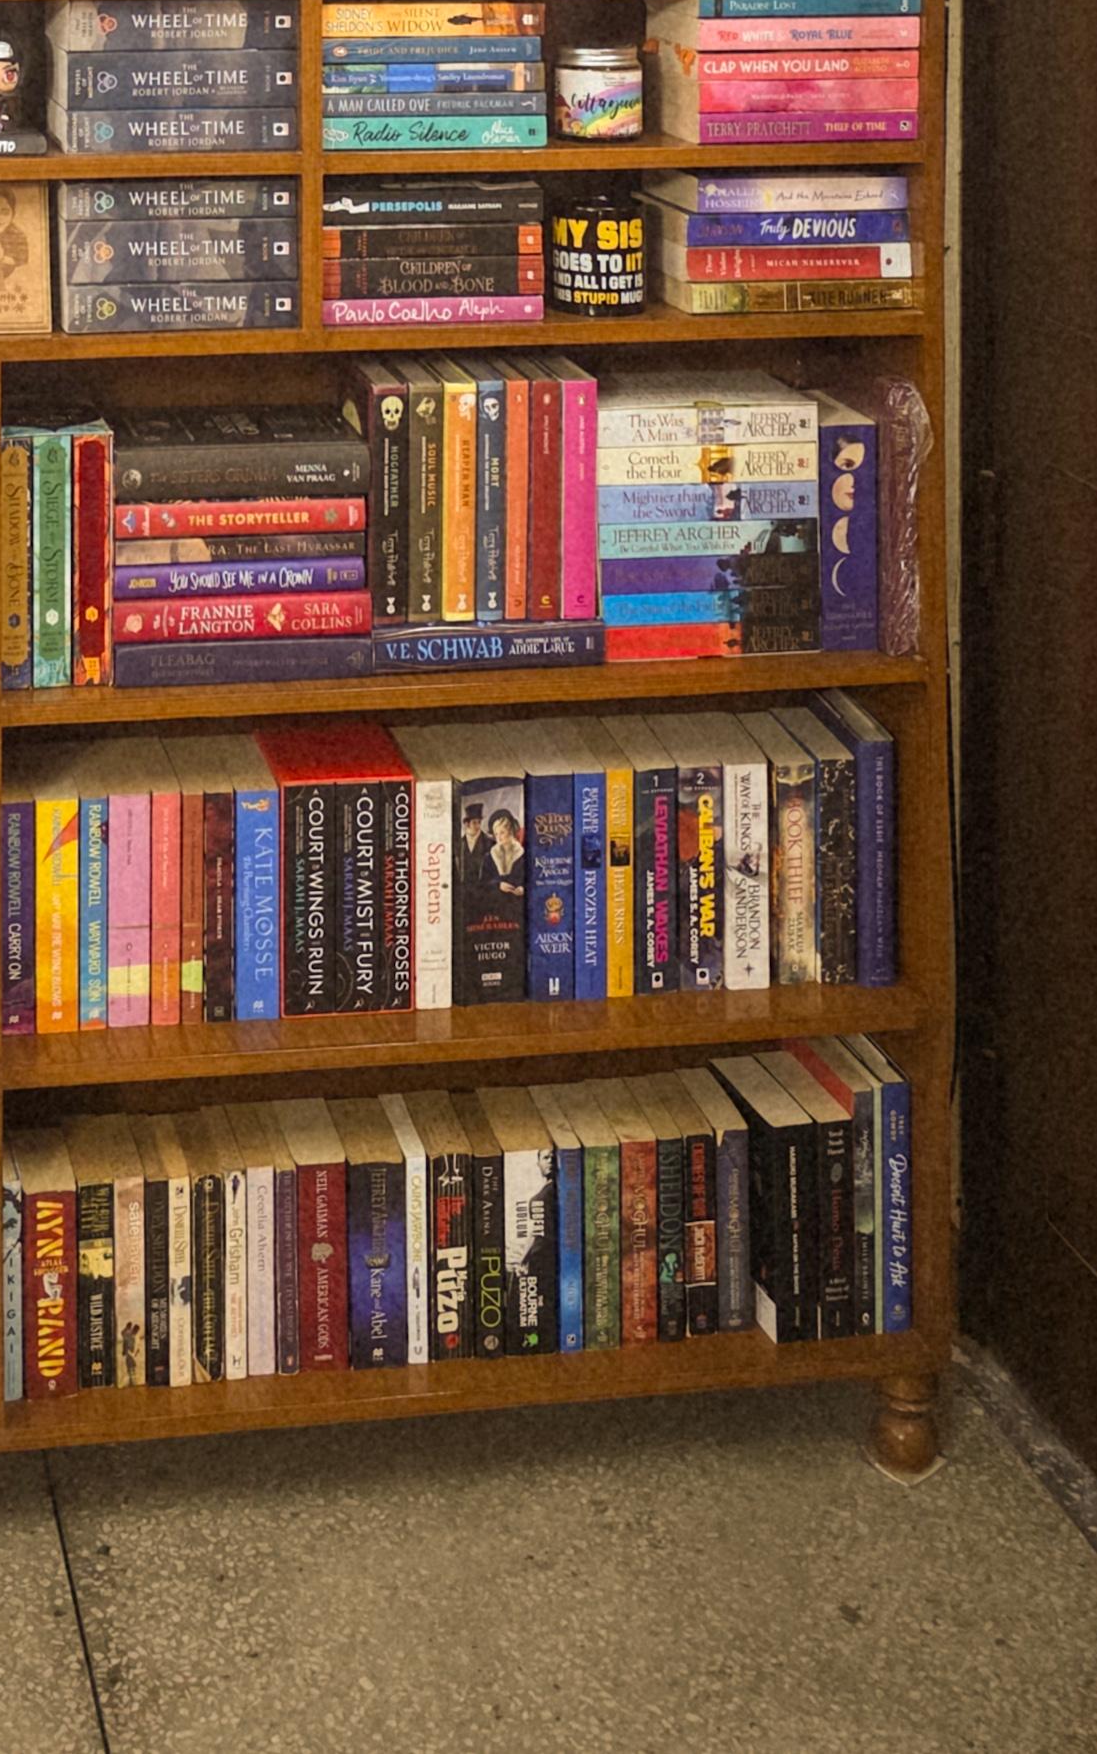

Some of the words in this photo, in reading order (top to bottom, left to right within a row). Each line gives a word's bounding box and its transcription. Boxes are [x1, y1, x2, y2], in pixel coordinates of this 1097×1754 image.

[704, 62, 736, 74] CLAP
[740, 61, 777, 73] WHEN
[781, 60, 811, 72] YOU
[815, 60, 849, 71] LAND
[327, 99, 334, 111] A
[338, 99, 364, 112] MAN
[367, 99, 405, 112] CALLED
[408, 99, 430, 111] OVE
[353, 122, 401, 142] Radio
[408, 122, 470, 142] Silence
[371, 202, 442, 212] PERSEPOLIS
[554, 219, 589, 246] MY
[596, 219, 643, 249] SIS
[793, 218, 856, 238] DEVIOUS
[597, 254, 622, 270] TO
[575, 274, 597, 288] ALL
[601, 276, 604, 288] I
[609, 274, 631, 287] GET
[573, 291, 618, 304] STUPID
[333, 301, 384, 323] Paulo
[388, 299, 452, 321] Coelho
[459, 300, 504, 316] Aleph
[628, 451, 680, 466] Cometh
[627, 463, 647, 478] the
[650, 465, 682, 479] Hour
[188, 515, 214, 526] THE
[219, 511, 310, 526] STORYTELLER
[612, 529, 670, 545] JEFFREY
[676, 526, 740, 541] ARCHER
[181, 606, 254, 619] FRANNIE
[304, 603, 341, 615] SARA
[179, 619, 255, 634] LANGTON
[291, 616, 352, 630] COLLINS
[418, 637, 503, 661] SCHWAB
[308, 797, 323, 864] COURT
[654, 796, 667, 889] LEVIATHAN
[423, 843, 446, 925] Sapiens
[308, 872, 323, 939] WINGS
[734, 879, 747, 959] SANDERSON
[654, 900, 667, 963] WAKES
[309, 950, 323, 995] RUIN
[481, 1256, 501, 1327] PUZO
[528, 1276, 538, 1326] BOURNE
[38, 1297, 66, 1379] RAND
